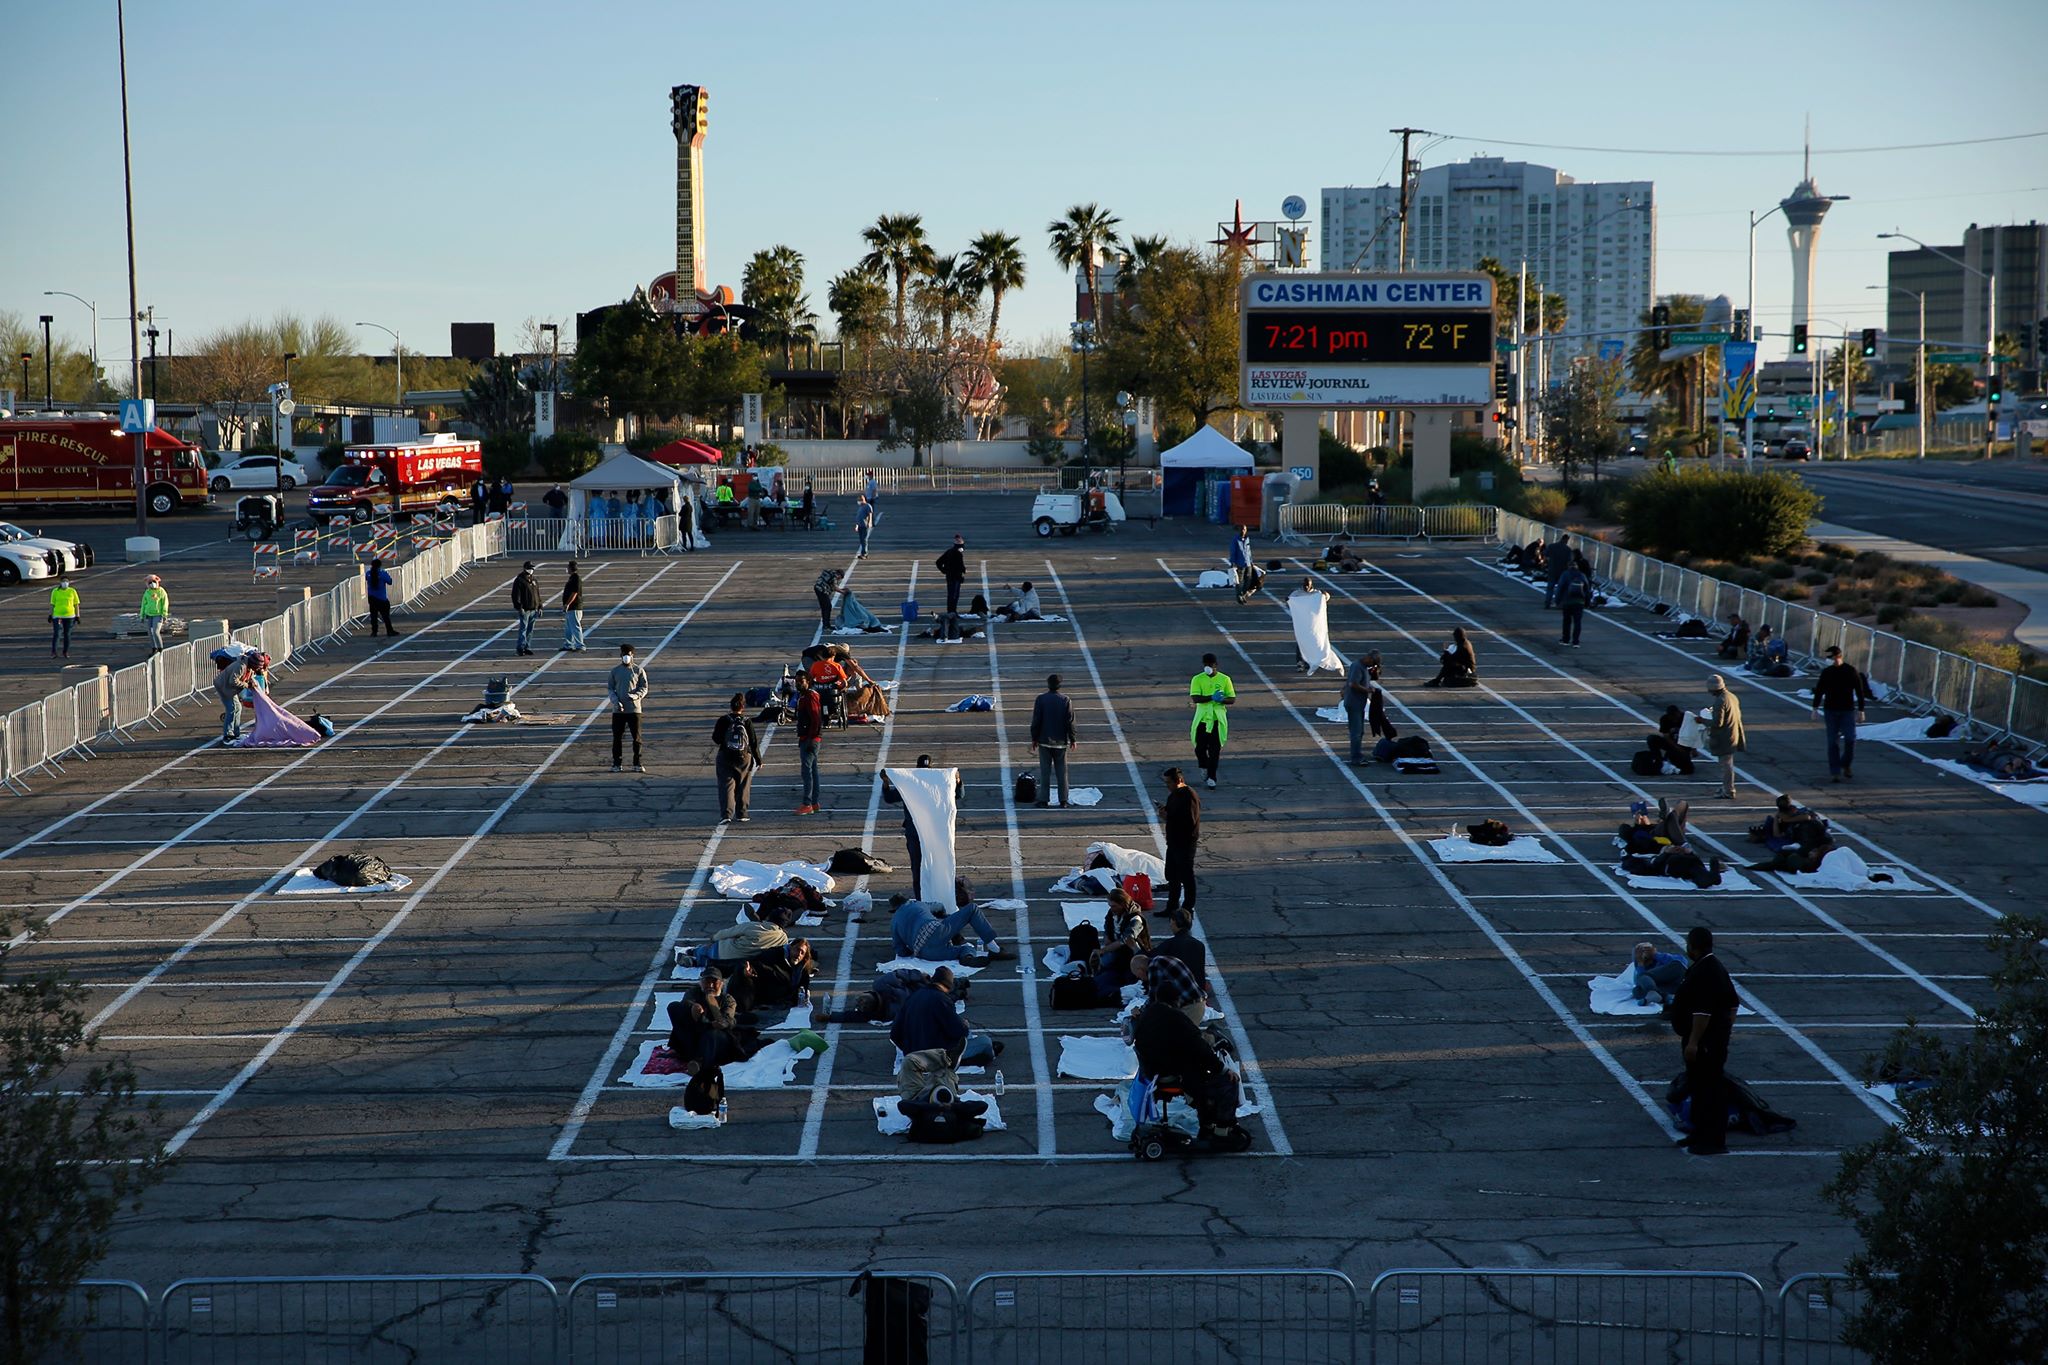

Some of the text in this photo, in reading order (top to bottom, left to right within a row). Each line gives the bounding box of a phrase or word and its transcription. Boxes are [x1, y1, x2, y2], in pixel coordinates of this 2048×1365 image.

[1257, 283, 1482, 302] CASHMAN CENTER
[1264, 325, 1368, 353] 7:21 pm
[1403, 324, 1433, 349] 72
[1251, 371, 1307, 379] LAS VEGAS
[1251, 379, 1370, 389] REVIEW-JOURNAL
[1251, 392, 1322, 400] LAS VEGAS SUN
[123, 404, 143, 429] A
[18, 431, 109, 466] FIRE & RESCUE
[54, 466, 88, 474] CENTER
[417, 456, 462, 471] LAS VEGAS
